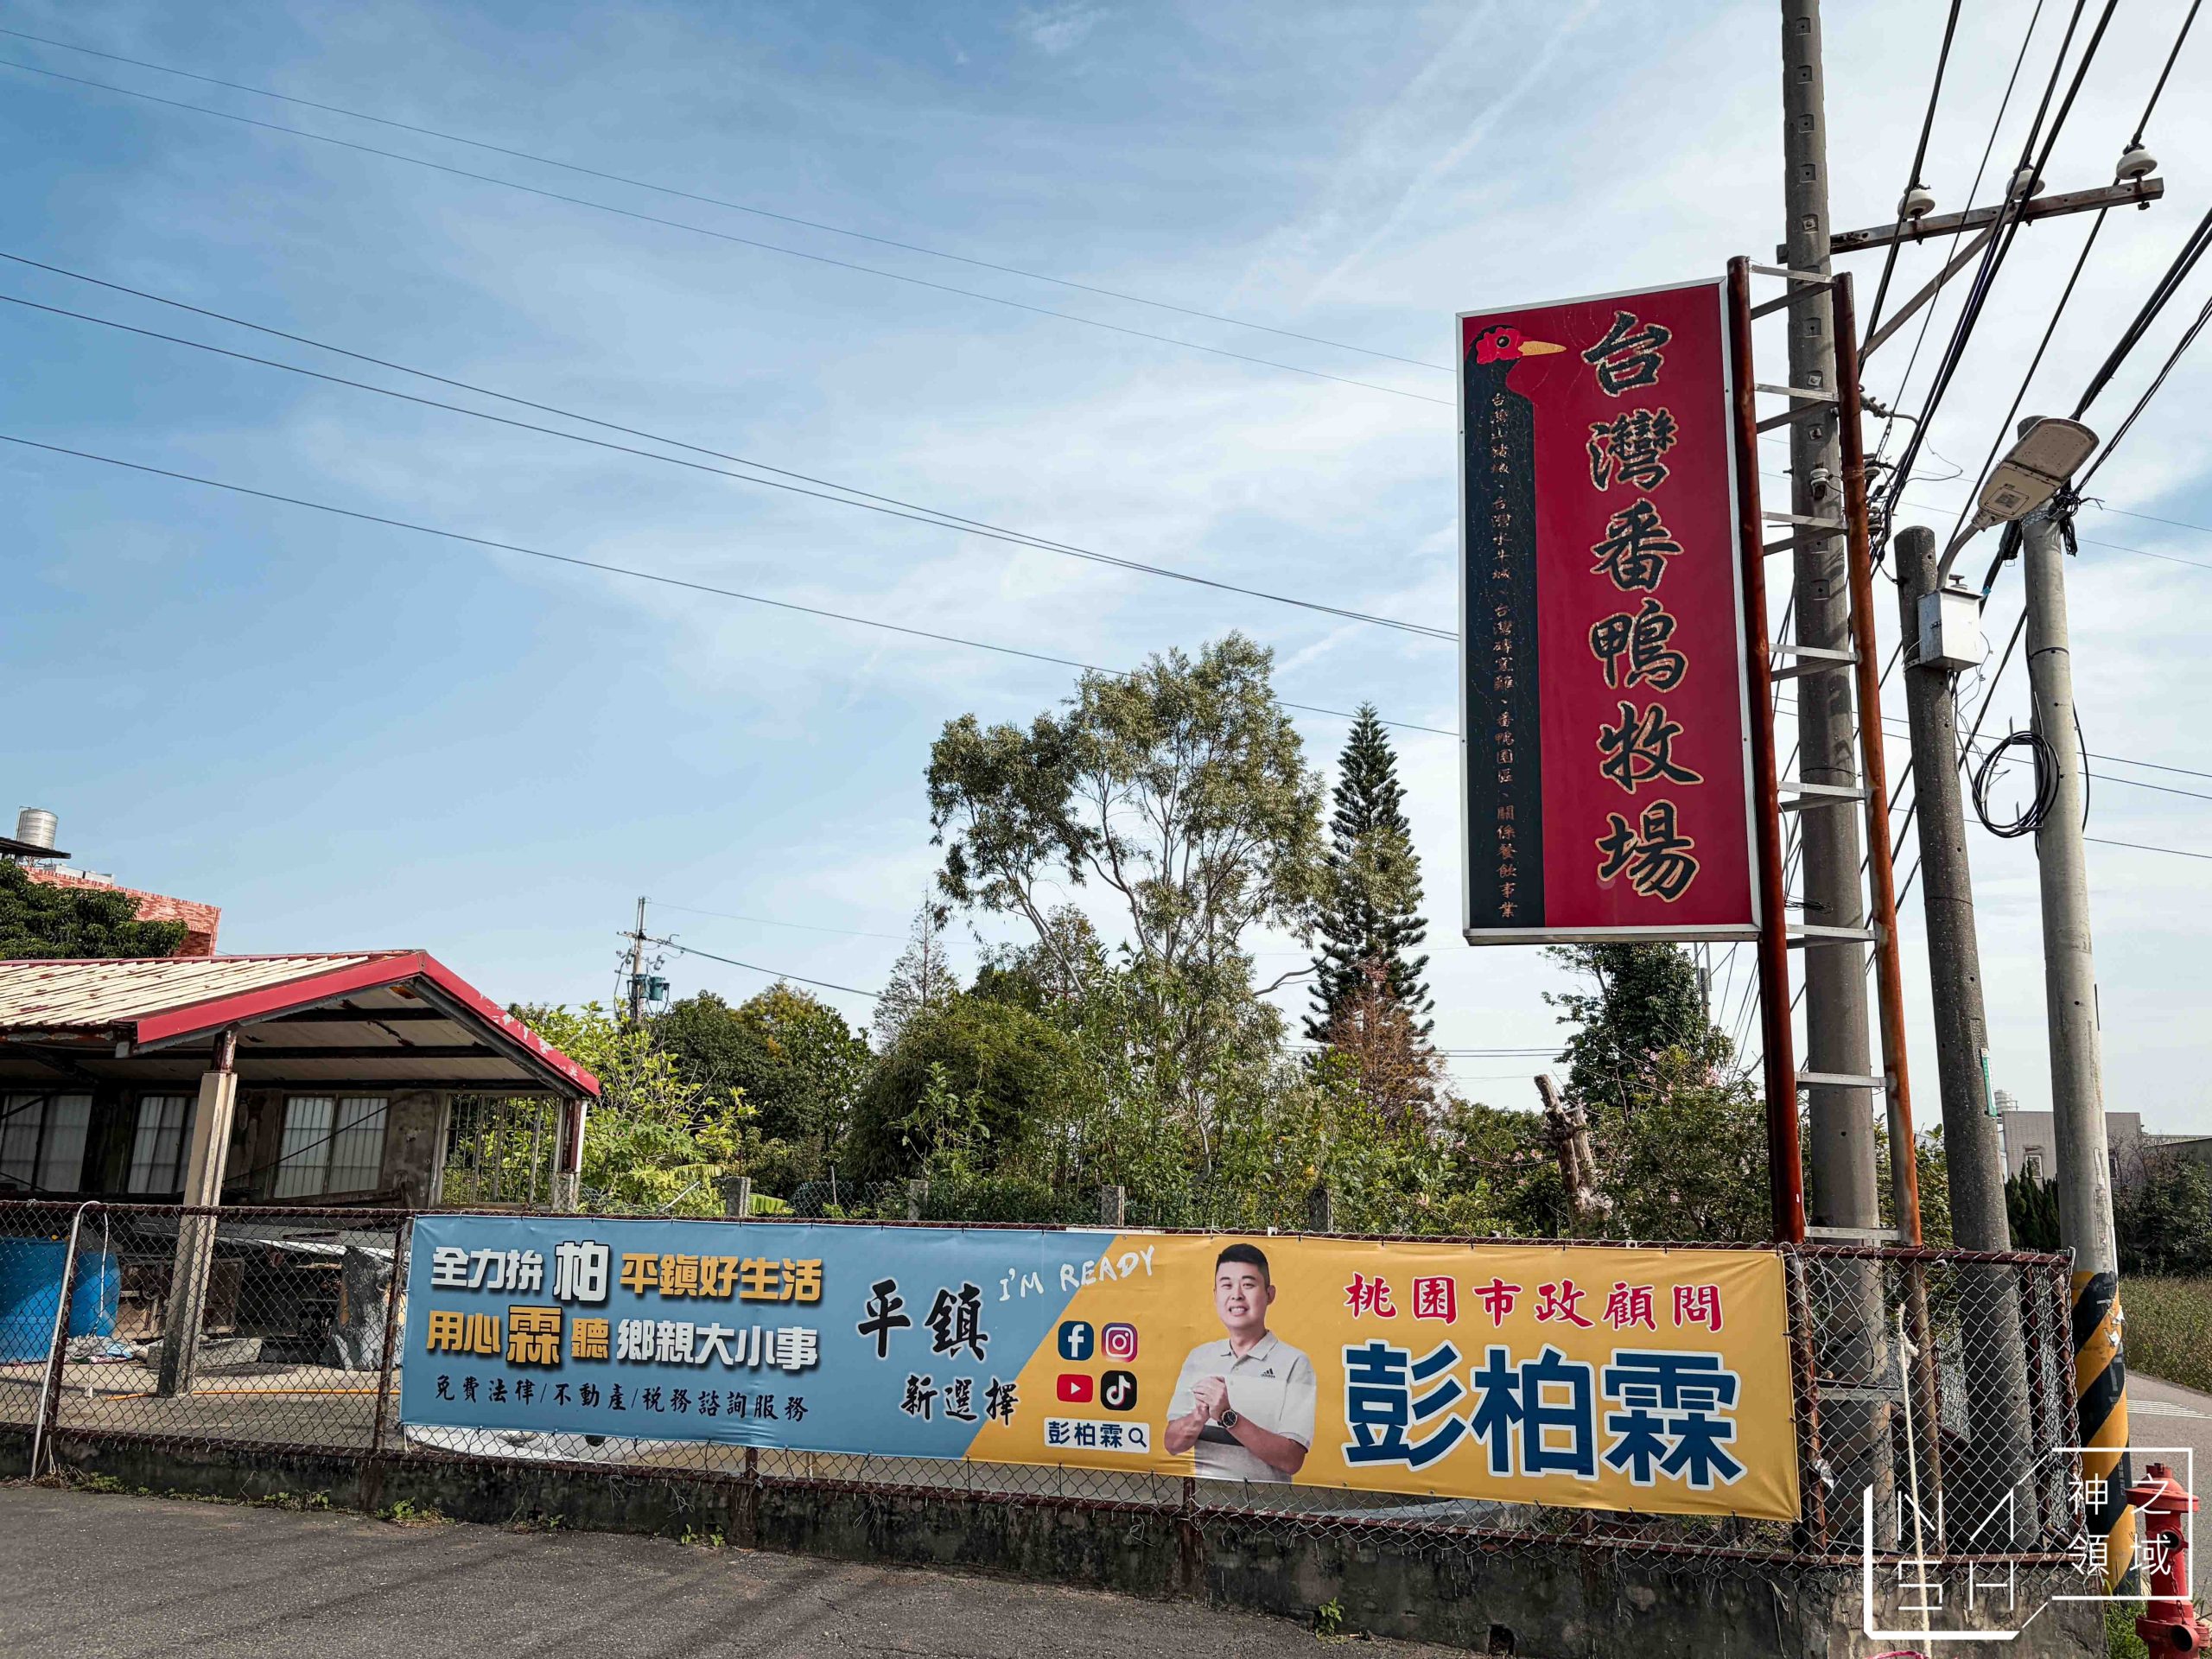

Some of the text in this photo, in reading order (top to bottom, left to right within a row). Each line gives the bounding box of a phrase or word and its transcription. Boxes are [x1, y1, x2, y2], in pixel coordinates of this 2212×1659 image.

[1580, 309, 1705, 903] 台灣番鴨牧場
[999, 1244, 1155, 1302] I'M READY
[1343, 1270, 1726, 1332] 桃園市政顧問
[856, 1278, 989, 1362] 平鎮
[899, 1374, 1020, 1426] 新選擇
[1342, 1338, 1747, 1490] 彭柏霖
[1047, 1421, 1123, 1448] 彭柏霖
